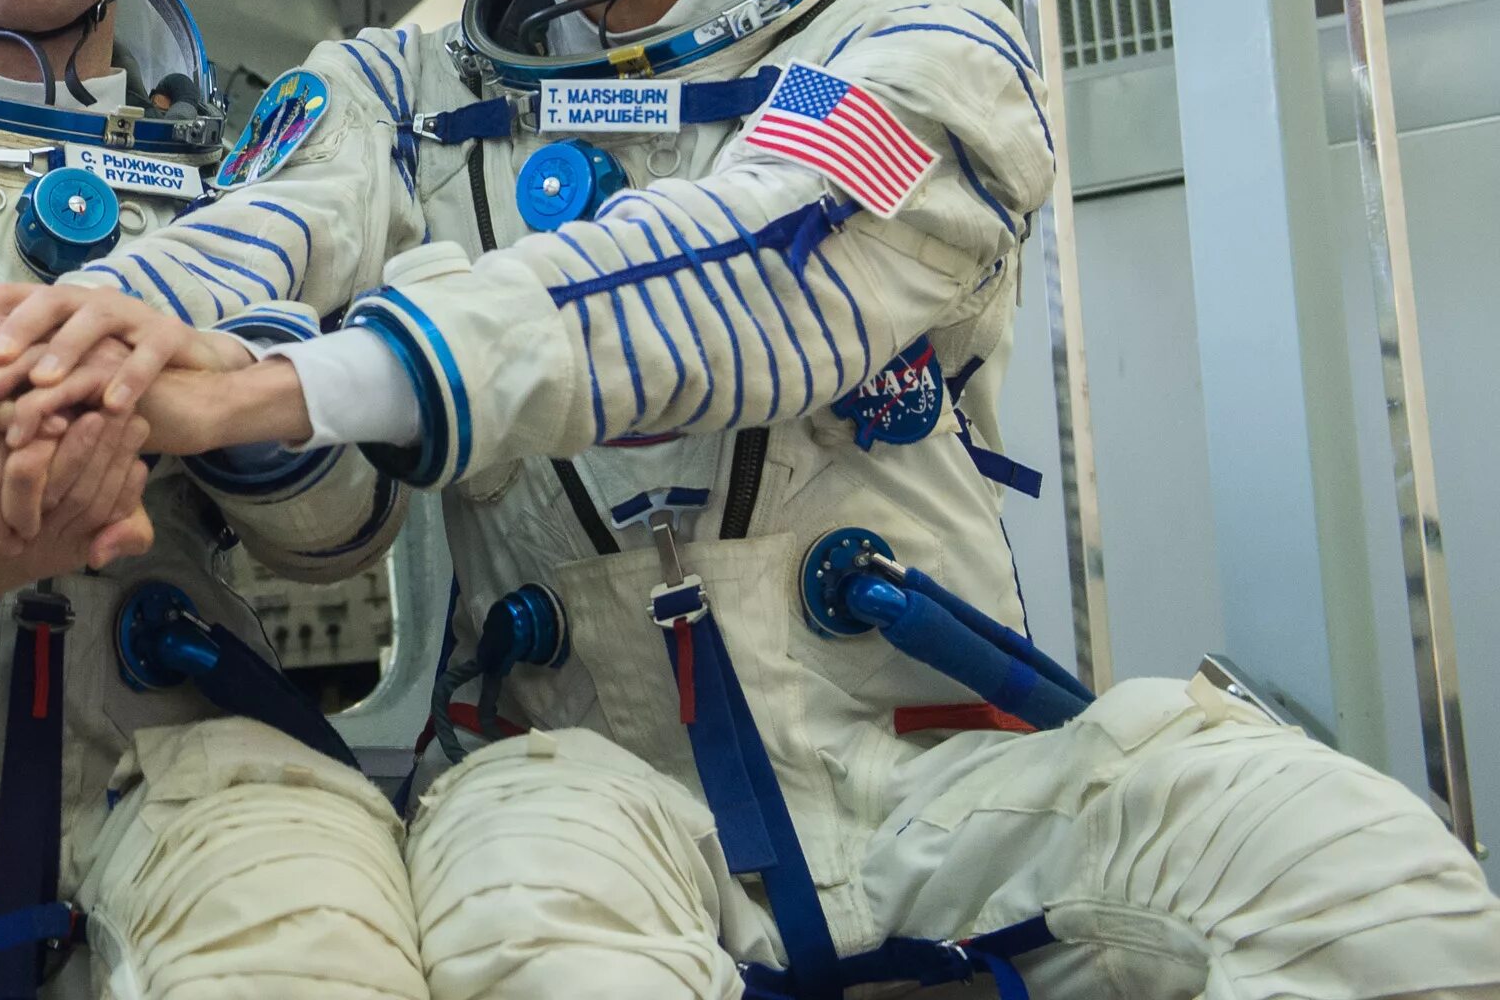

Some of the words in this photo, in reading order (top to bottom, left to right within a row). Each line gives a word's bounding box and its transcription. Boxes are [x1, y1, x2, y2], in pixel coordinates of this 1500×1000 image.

[548, 88, 562, 104] T.
[567, 88, 668, 104] MARSHBURN
[547, 109, 562, 124] Т.
[568, 105, 668, 124] МАРШБЁРН
[81, 150, 97, 165] С.
[102, 153, 185, 178] РЫЖИКОВ
[105, 168, 183, 190] RYZHIKOV
[858, 365, 937, 398] NASA
